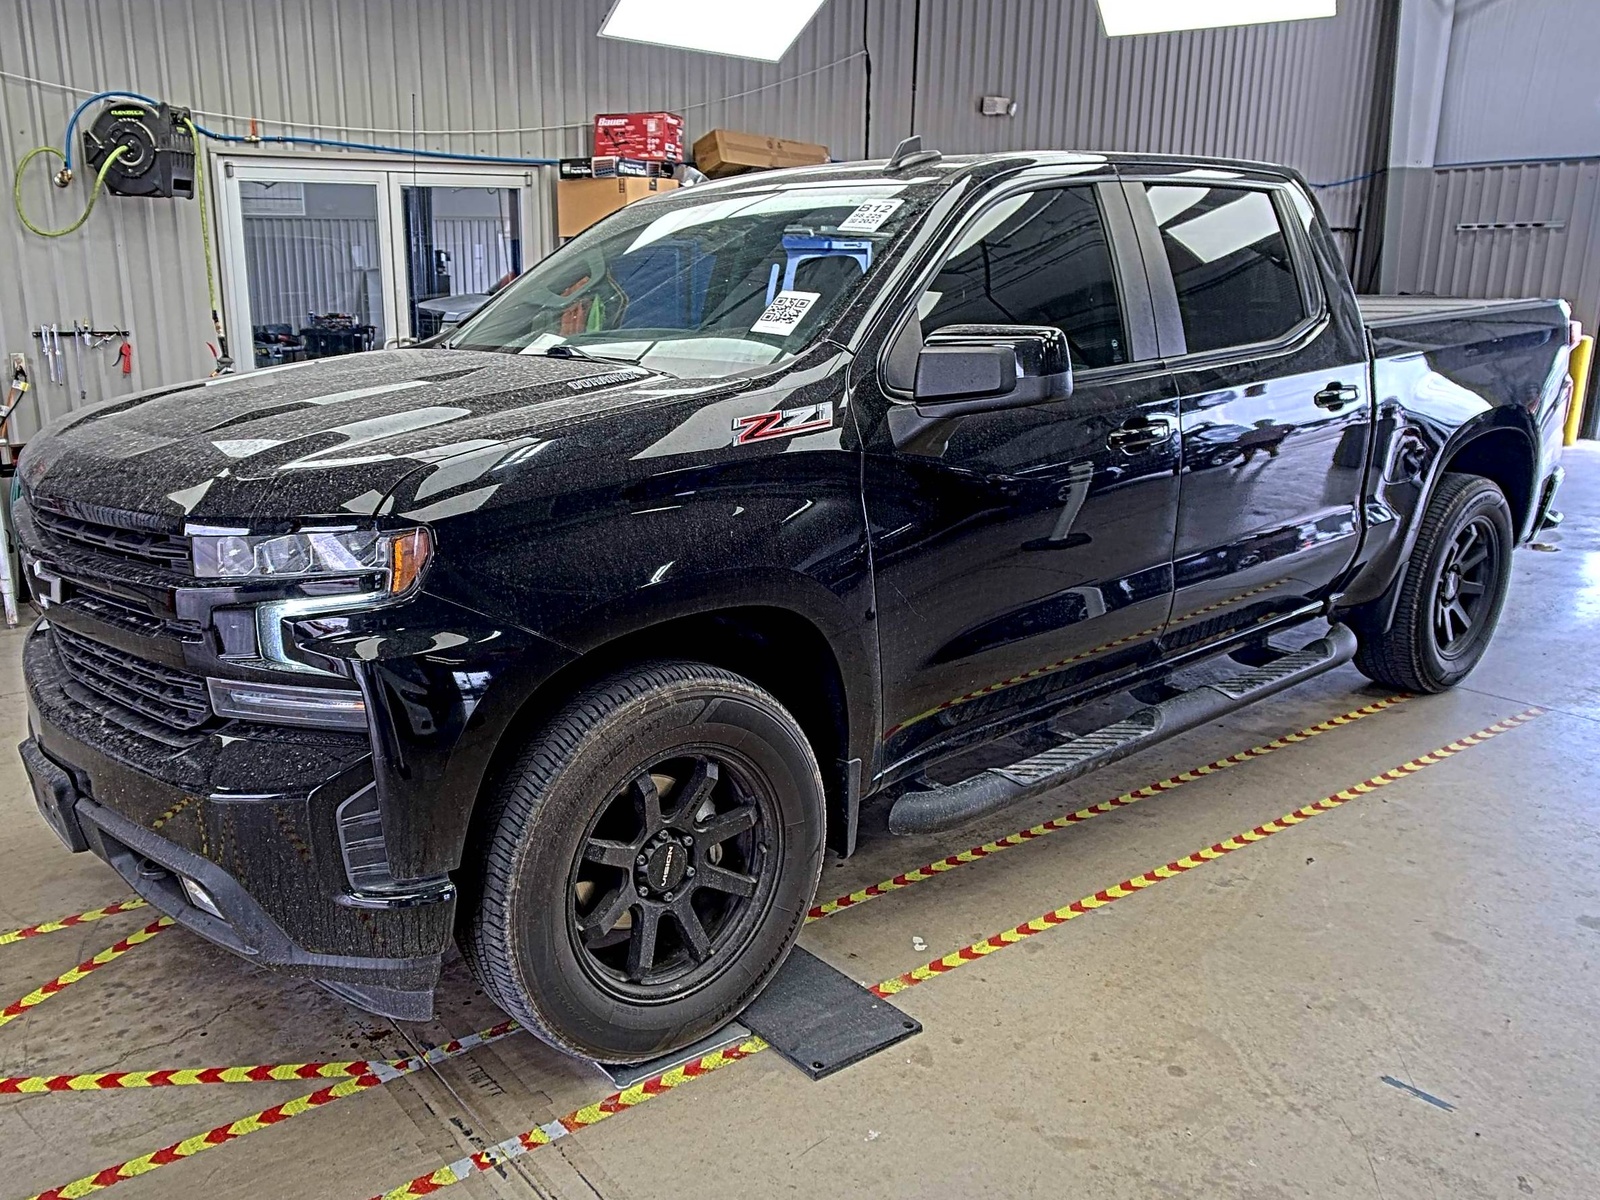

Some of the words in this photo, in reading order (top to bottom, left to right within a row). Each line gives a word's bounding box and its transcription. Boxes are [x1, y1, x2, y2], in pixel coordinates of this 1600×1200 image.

[597, 117, 629, 127] Bauer
[858, 204, 893, 213] B12
[567, 370, 641, 390] DURAMAX
[660, 846, 674, 887] VISION
